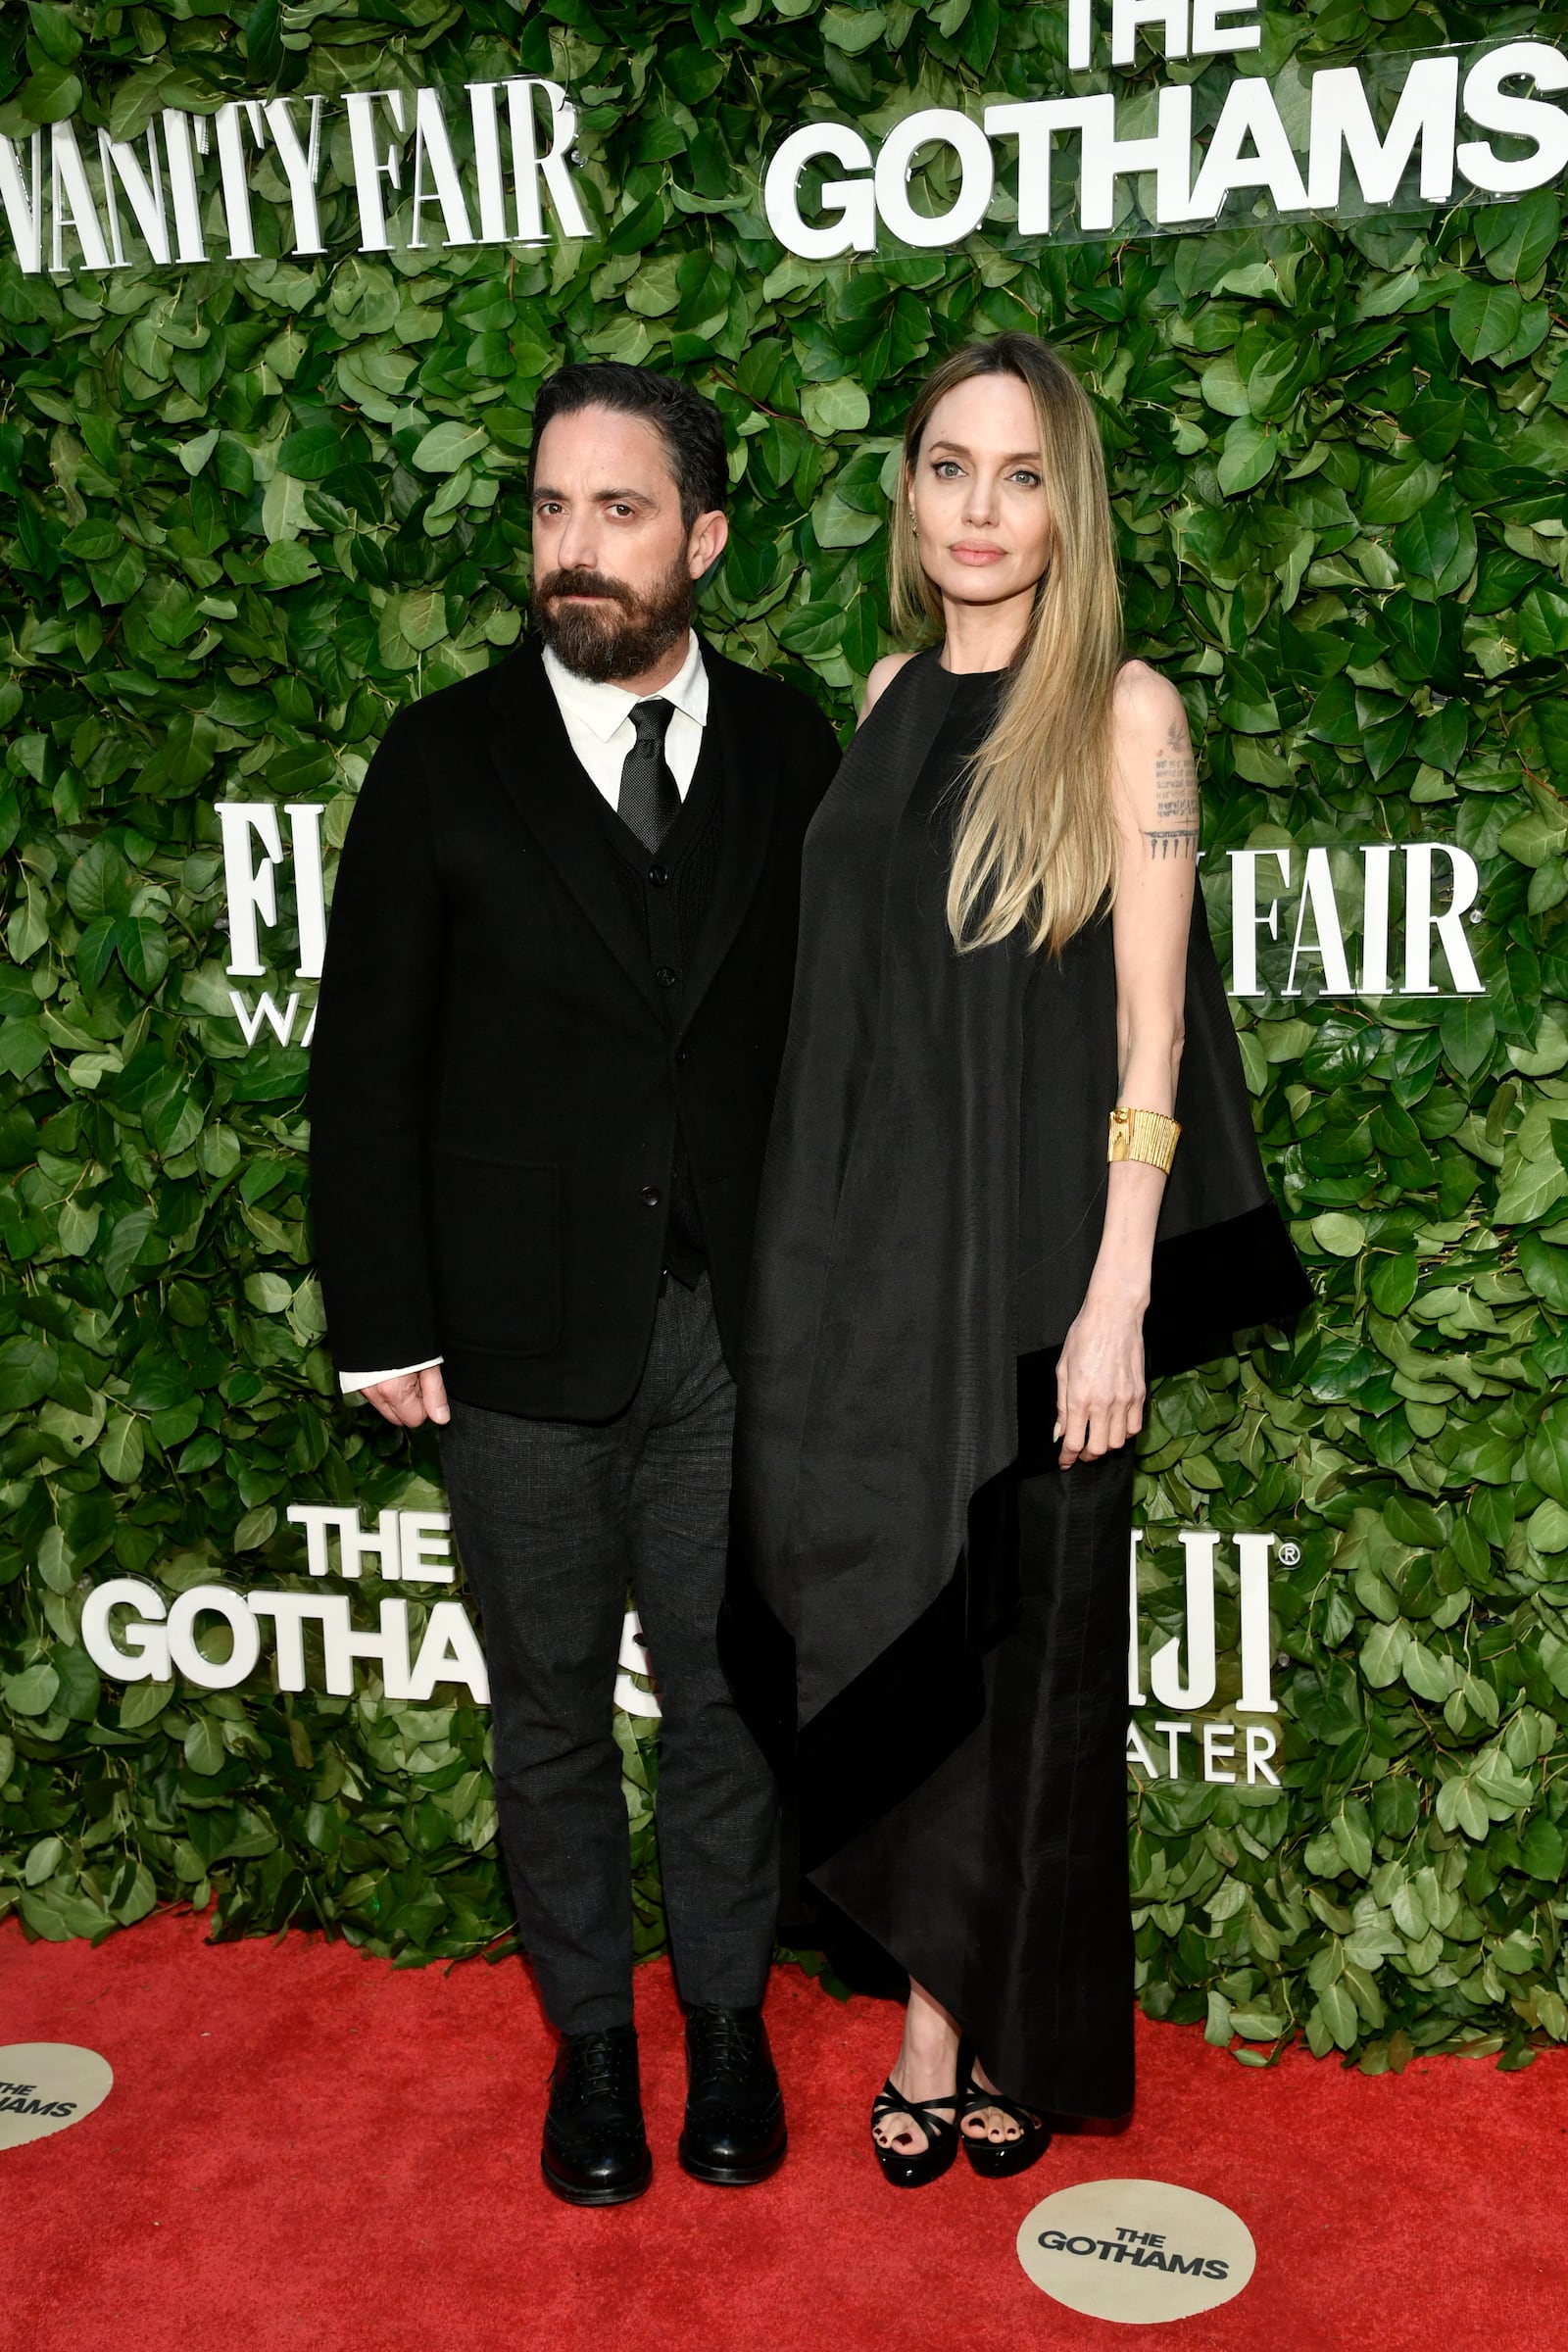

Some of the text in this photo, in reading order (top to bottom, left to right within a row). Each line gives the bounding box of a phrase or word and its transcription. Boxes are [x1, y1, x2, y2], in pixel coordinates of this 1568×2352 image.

[0, 78, 593, 273] VANITY FAIR
[765, 41, 1568, 259] GOTHAMS
[214, 803, 326, 978] FI
[1226, 843, 1486, 997] FAIR
[286, 1504, 455, 1584] THE
[81, 1578, 662, 1718] GOTHA
[1126, 1720, 1281, 1786] ATER
[1037, 2230, 1230, 2280] GOTHAMS
[1115, 2227, 1166, 2249] THE
